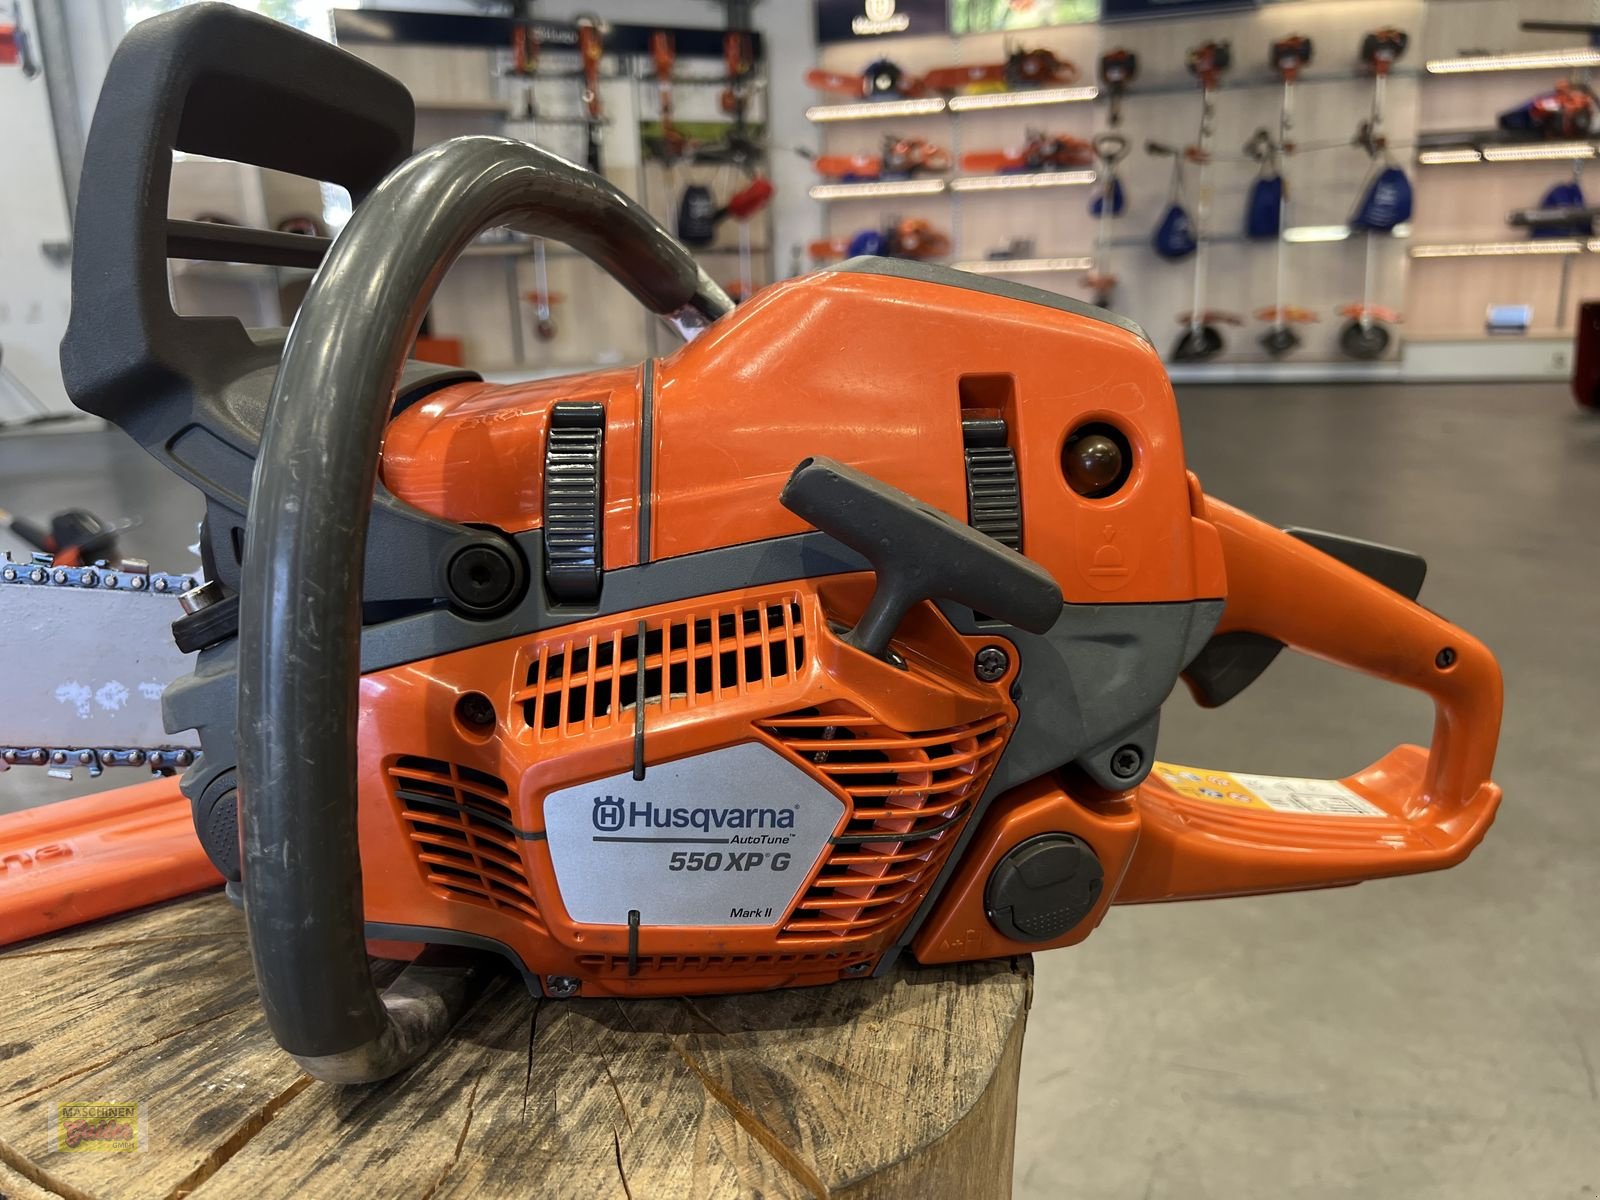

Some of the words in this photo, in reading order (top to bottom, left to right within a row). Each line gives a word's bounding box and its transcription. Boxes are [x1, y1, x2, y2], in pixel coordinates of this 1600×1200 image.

[669, 851, 723, 872] 550
[770, 851, 791, 872] G
[730, 906, 762, 919] Mark
[764, 906, 773, 919] II
